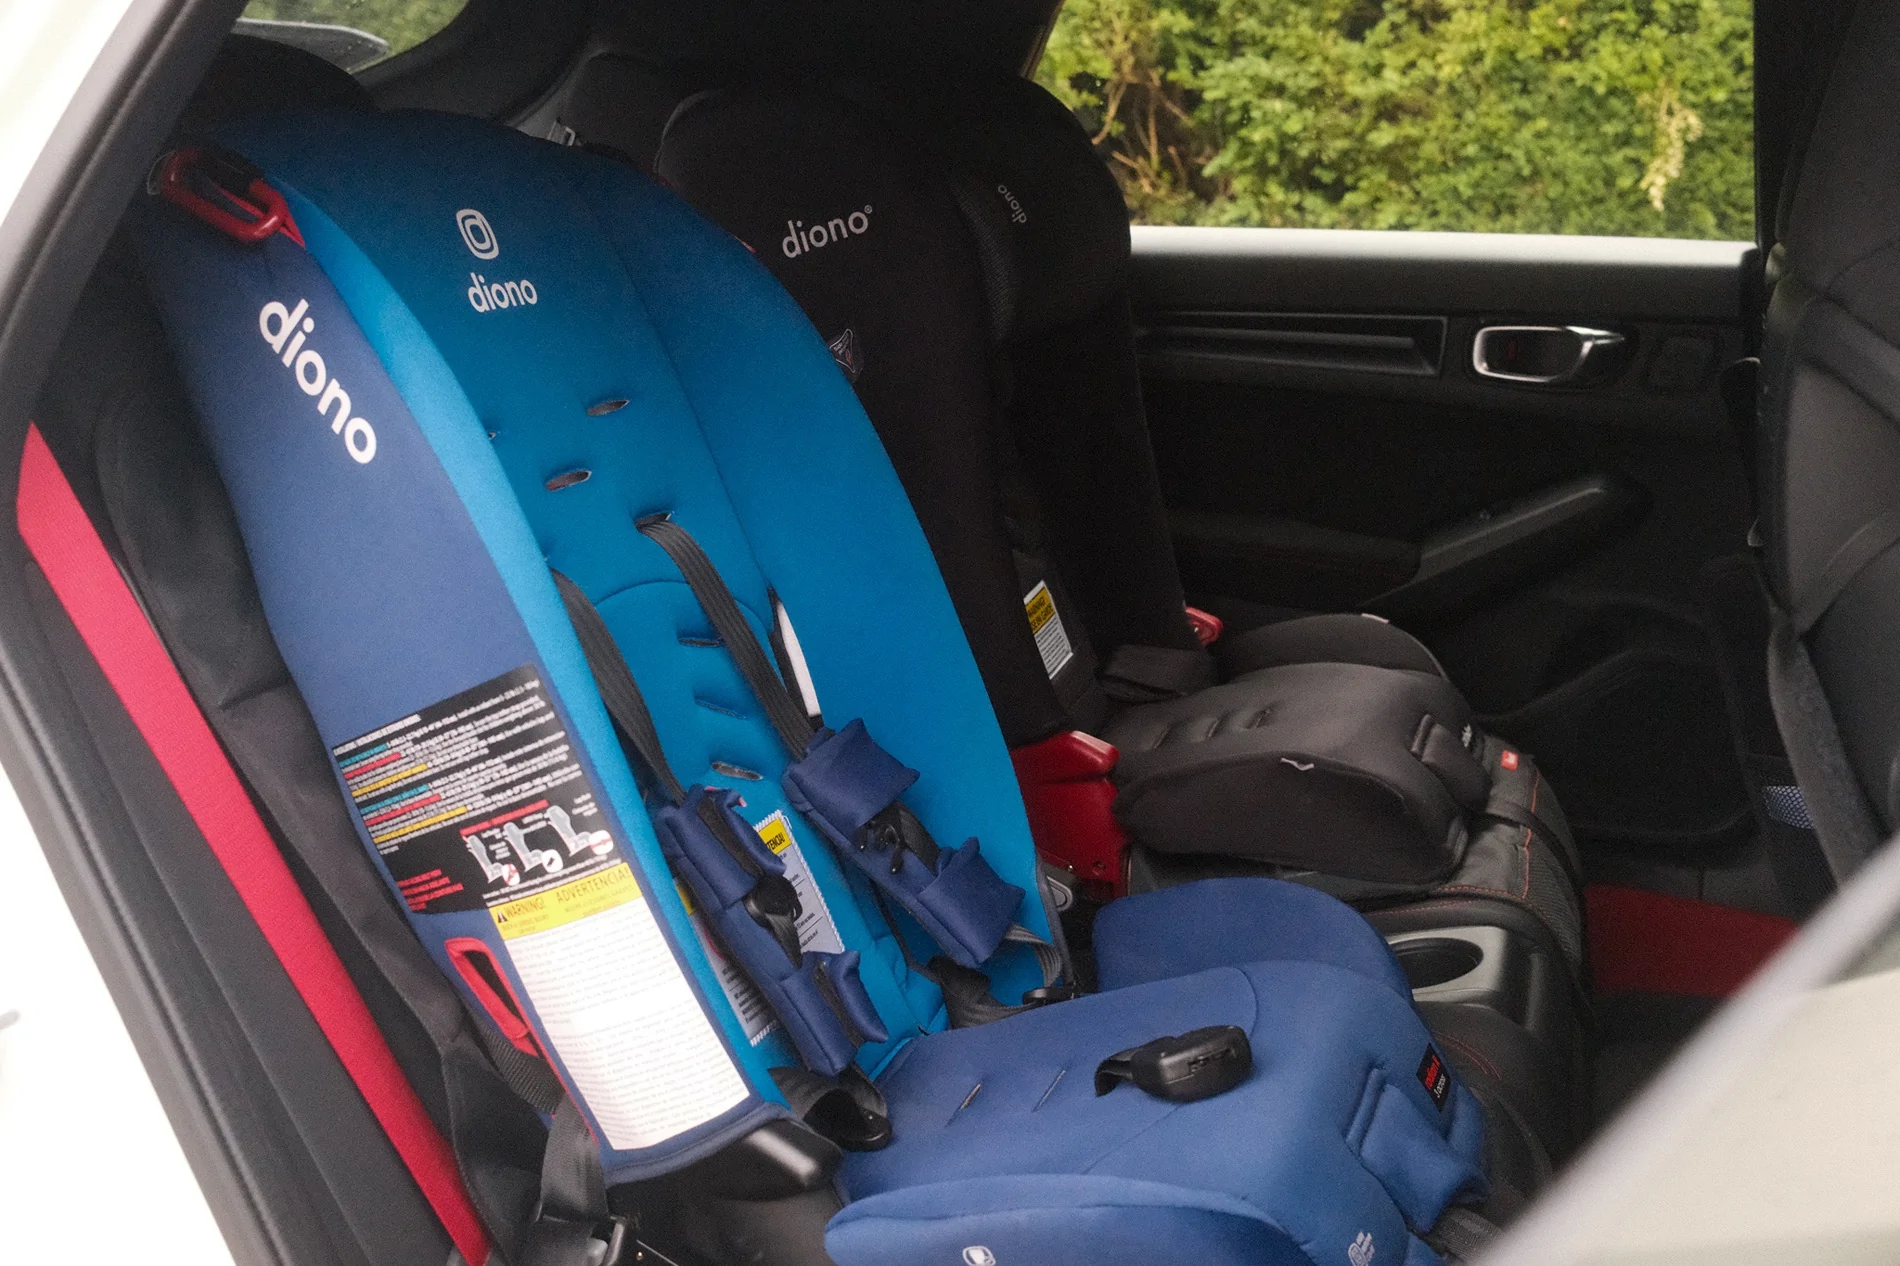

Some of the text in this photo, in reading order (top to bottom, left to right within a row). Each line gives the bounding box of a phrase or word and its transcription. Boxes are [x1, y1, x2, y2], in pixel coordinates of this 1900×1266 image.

[998, 185, 1027, 224] diono
[467, 272, 538, 314] diono
[258, 298, 377, 465] diono
[555, 866, 630, 904] ADVERTENCIA!
